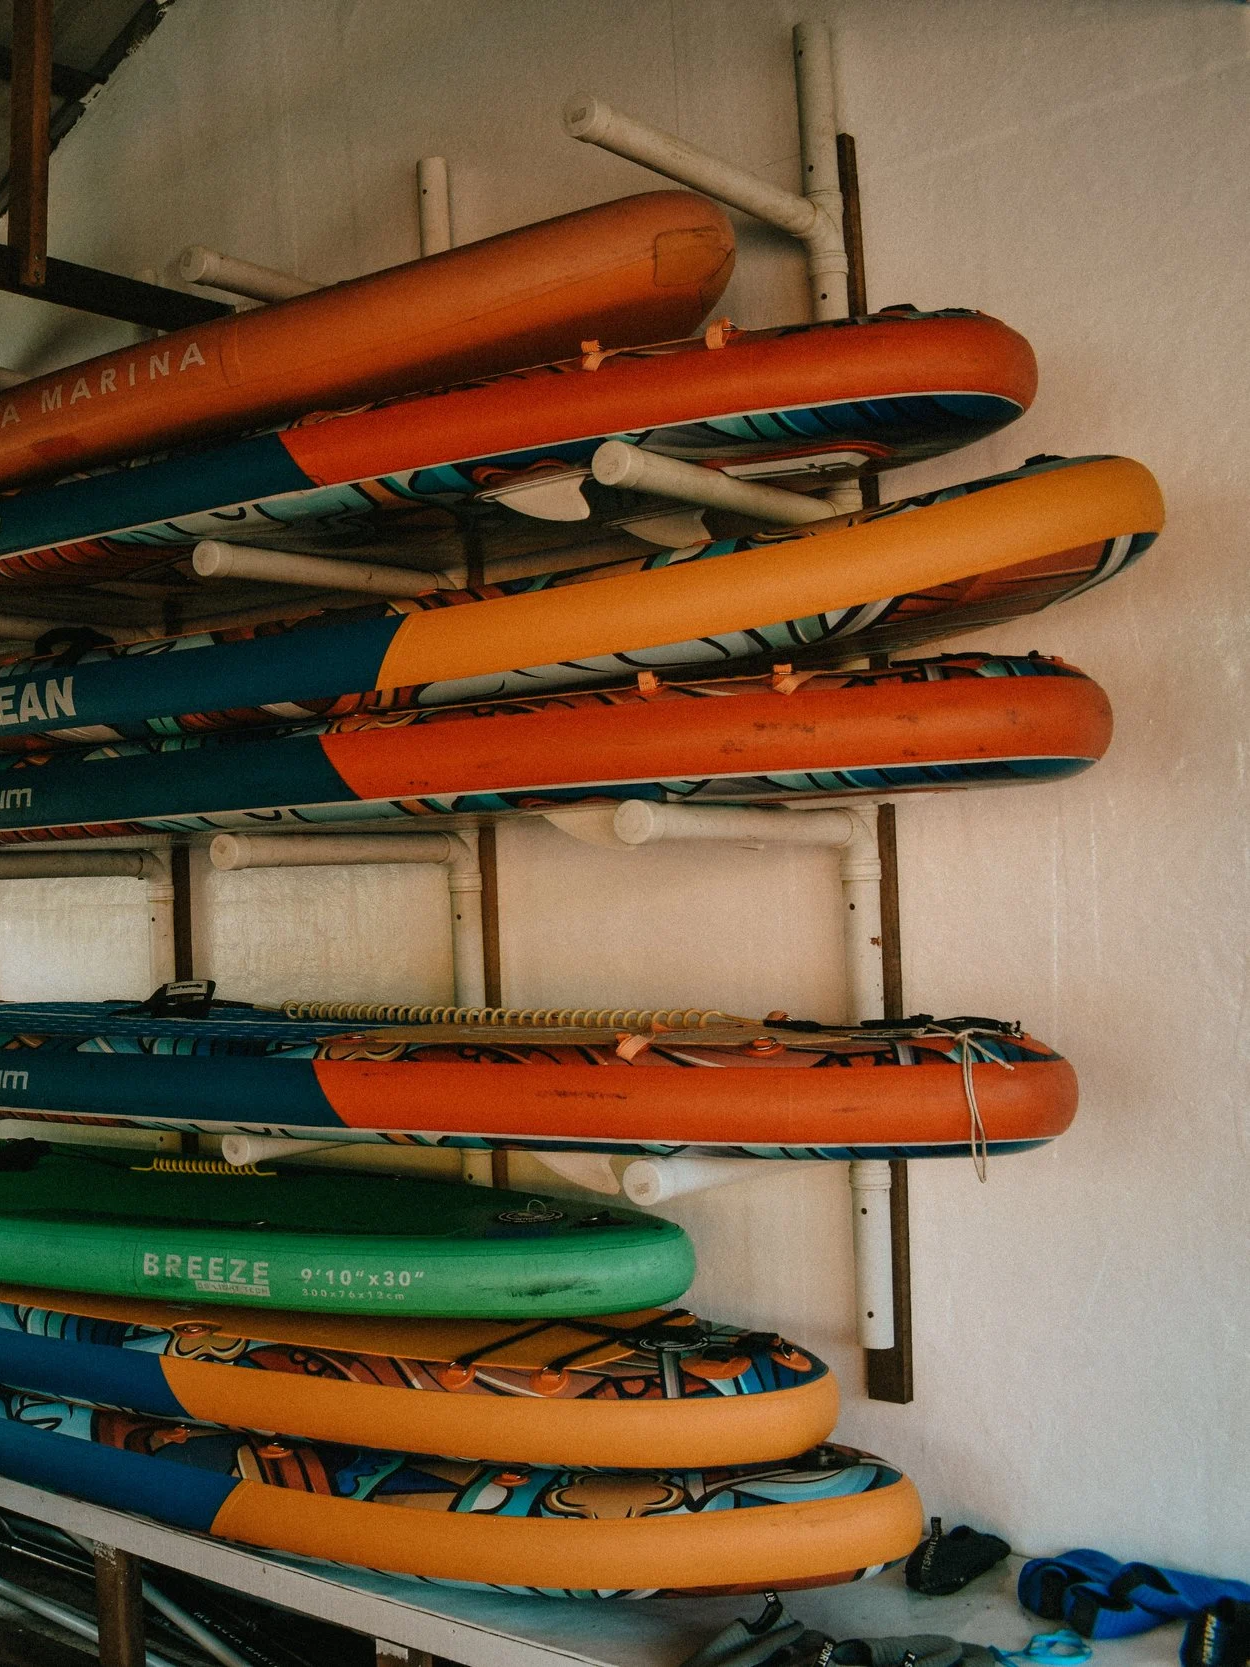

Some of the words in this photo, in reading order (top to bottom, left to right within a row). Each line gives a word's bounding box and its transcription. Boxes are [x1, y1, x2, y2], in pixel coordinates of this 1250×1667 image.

[40, 342, 206, 414] MARINA
[143, 1252, 270, 1285] BREEZE
[302, 1288, 405, 1301] 300x76x12cm
